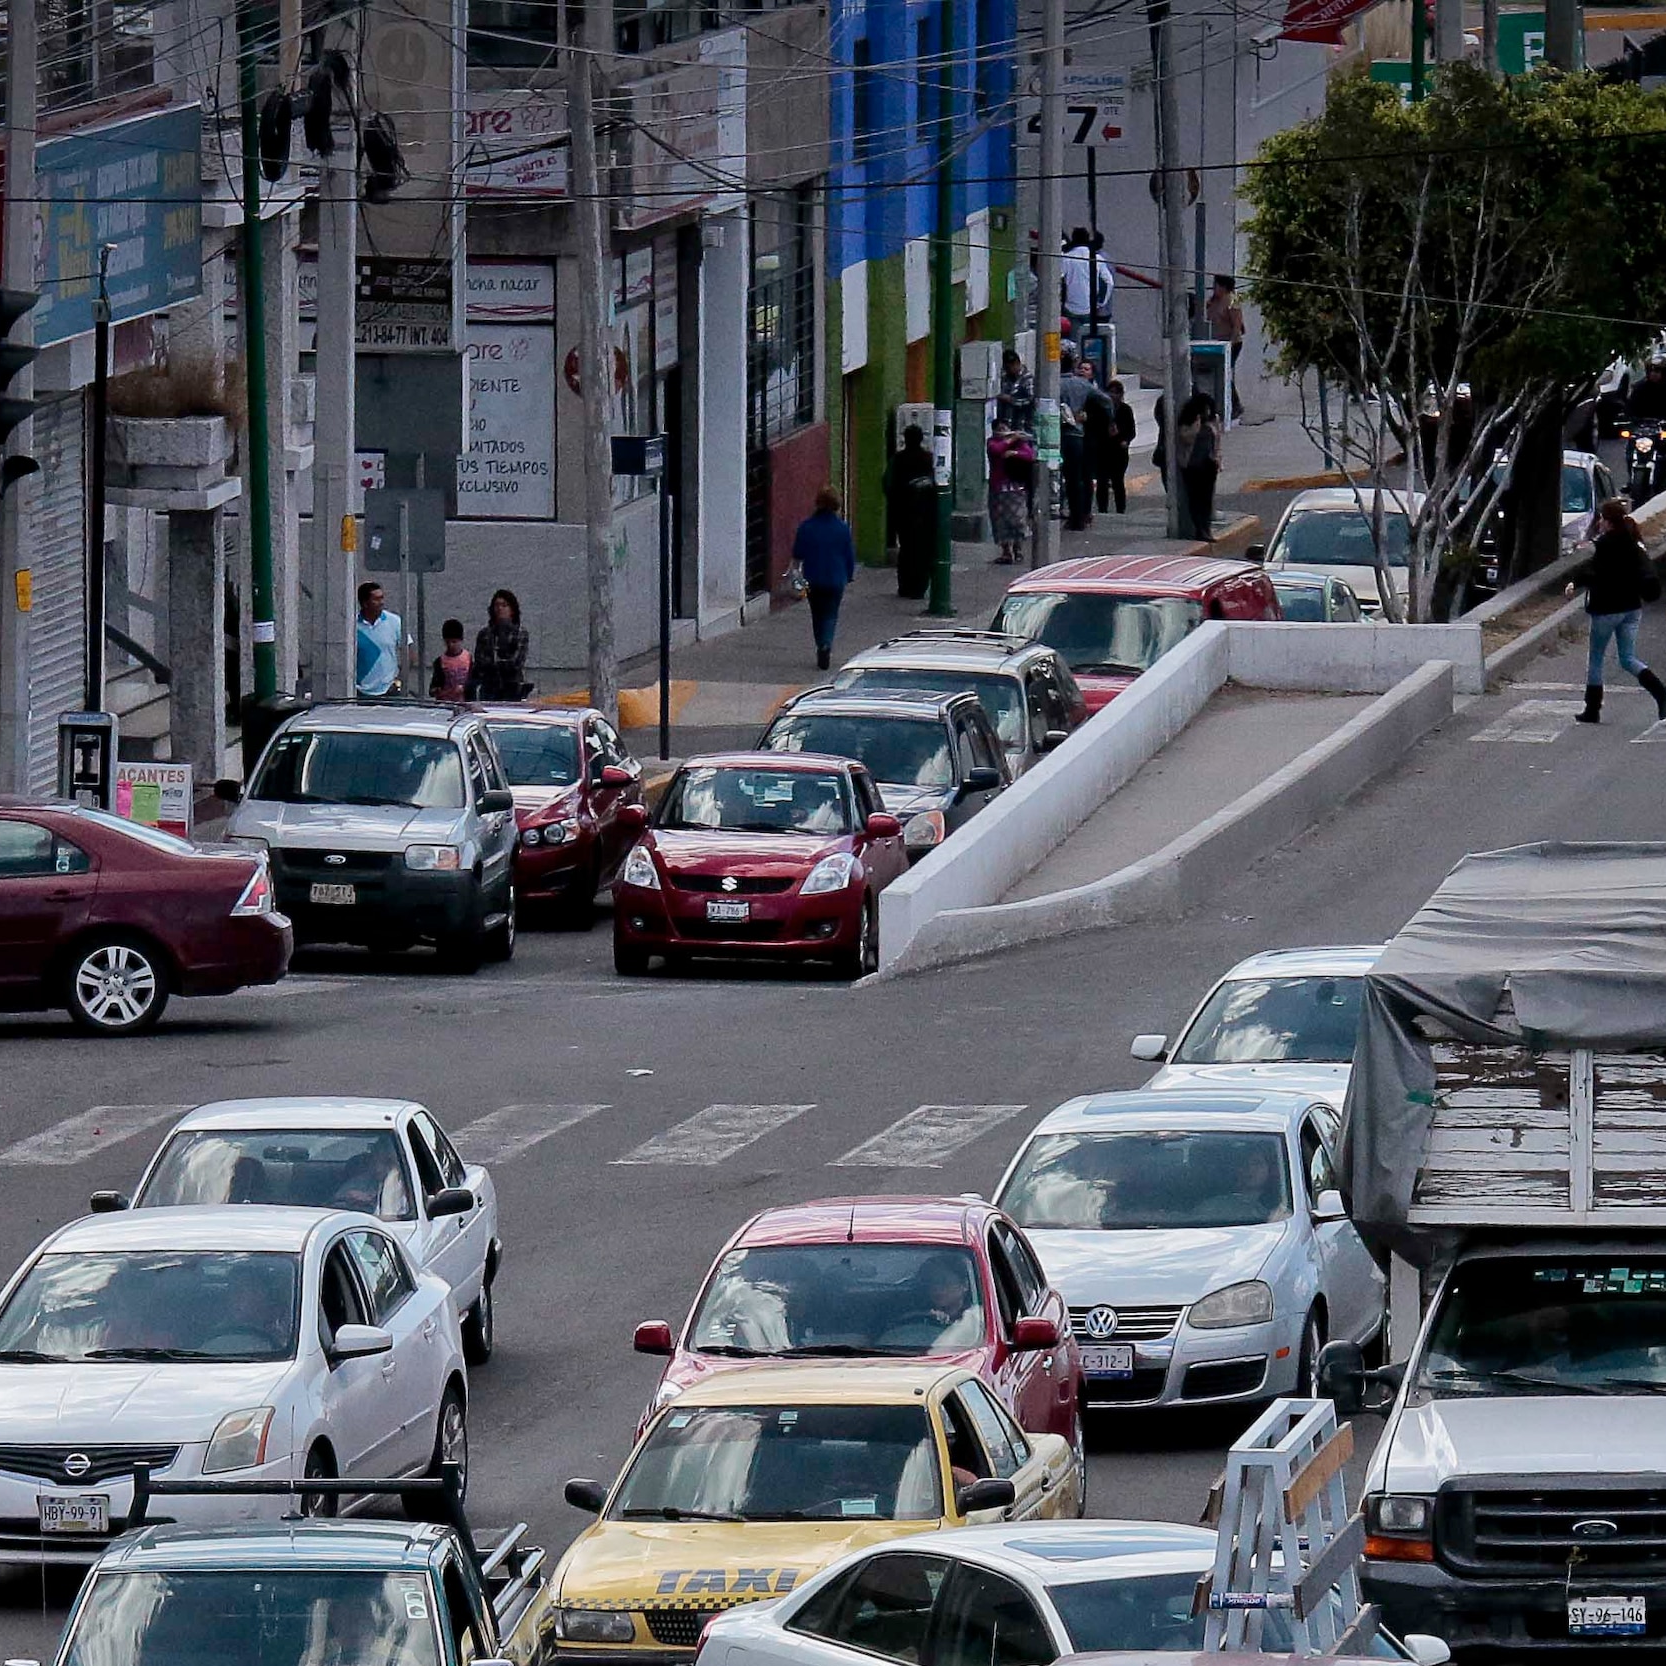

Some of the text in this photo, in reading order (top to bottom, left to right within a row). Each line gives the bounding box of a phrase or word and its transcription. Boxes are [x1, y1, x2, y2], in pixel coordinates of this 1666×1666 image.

[485, 460, 549, 475] TIEMPOS
[44, 1505, 102, 1521] HBY-99-91
[655, 1567, 801, 1593] TAXI
